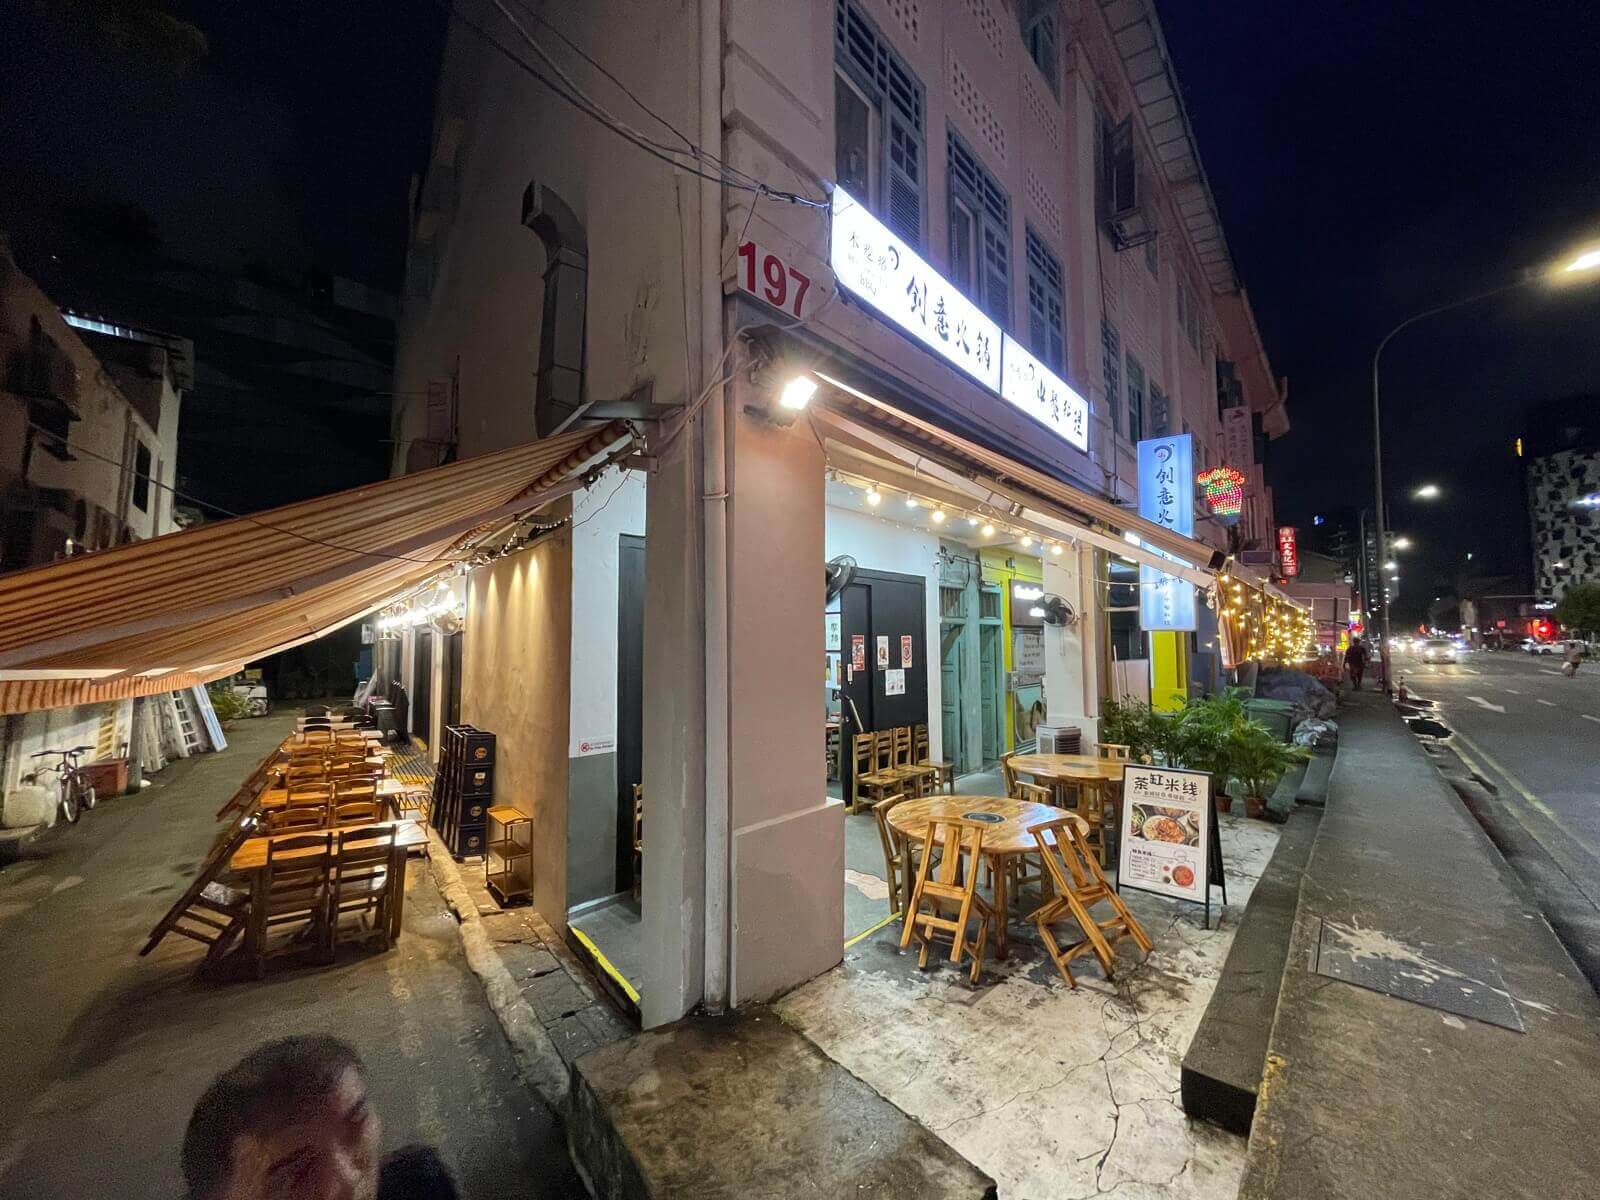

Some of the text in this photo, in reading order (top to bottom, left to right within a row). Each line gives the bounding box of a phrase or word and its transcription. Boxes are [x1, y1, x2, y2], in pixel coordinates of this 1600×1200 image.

[738, 241, 810, 318] 197
[906, 275, 991, 371] 创意火锅
[1134, 773, 1199, 797] 茶缸米线
